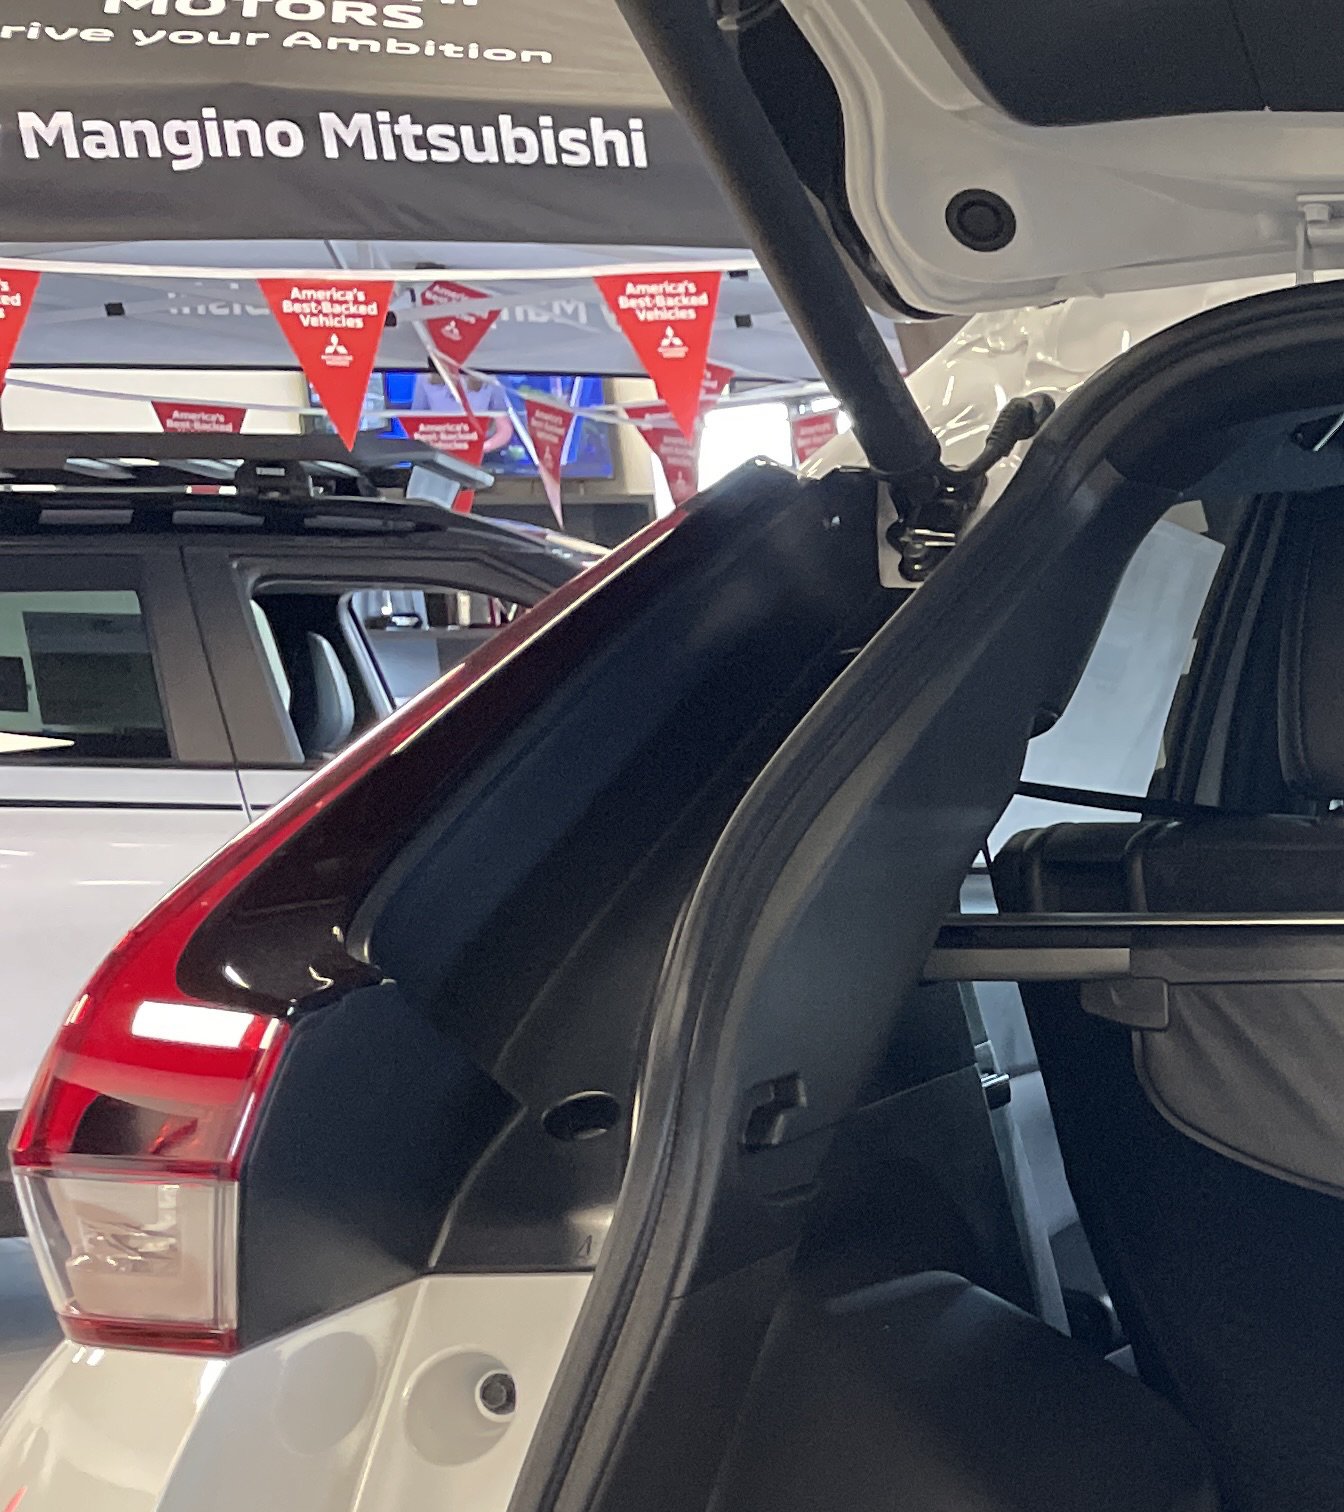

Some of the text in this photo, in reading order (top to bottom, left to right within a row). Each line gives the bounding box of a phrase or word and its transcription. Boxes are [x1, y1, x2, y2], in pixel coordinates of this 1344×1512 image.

[0, 21, 552, 63] rive your Ambition
[17, 106, 648, 172] Mangino Mitsubishi
[290, 286, 366, 302] America's
[625, 279, 697, 296] America's
[282, 299, 379, 316] Best-Backed
[634, 307, 697, 322] Vehicles
[299, 314, 364, 329] Vehicles
